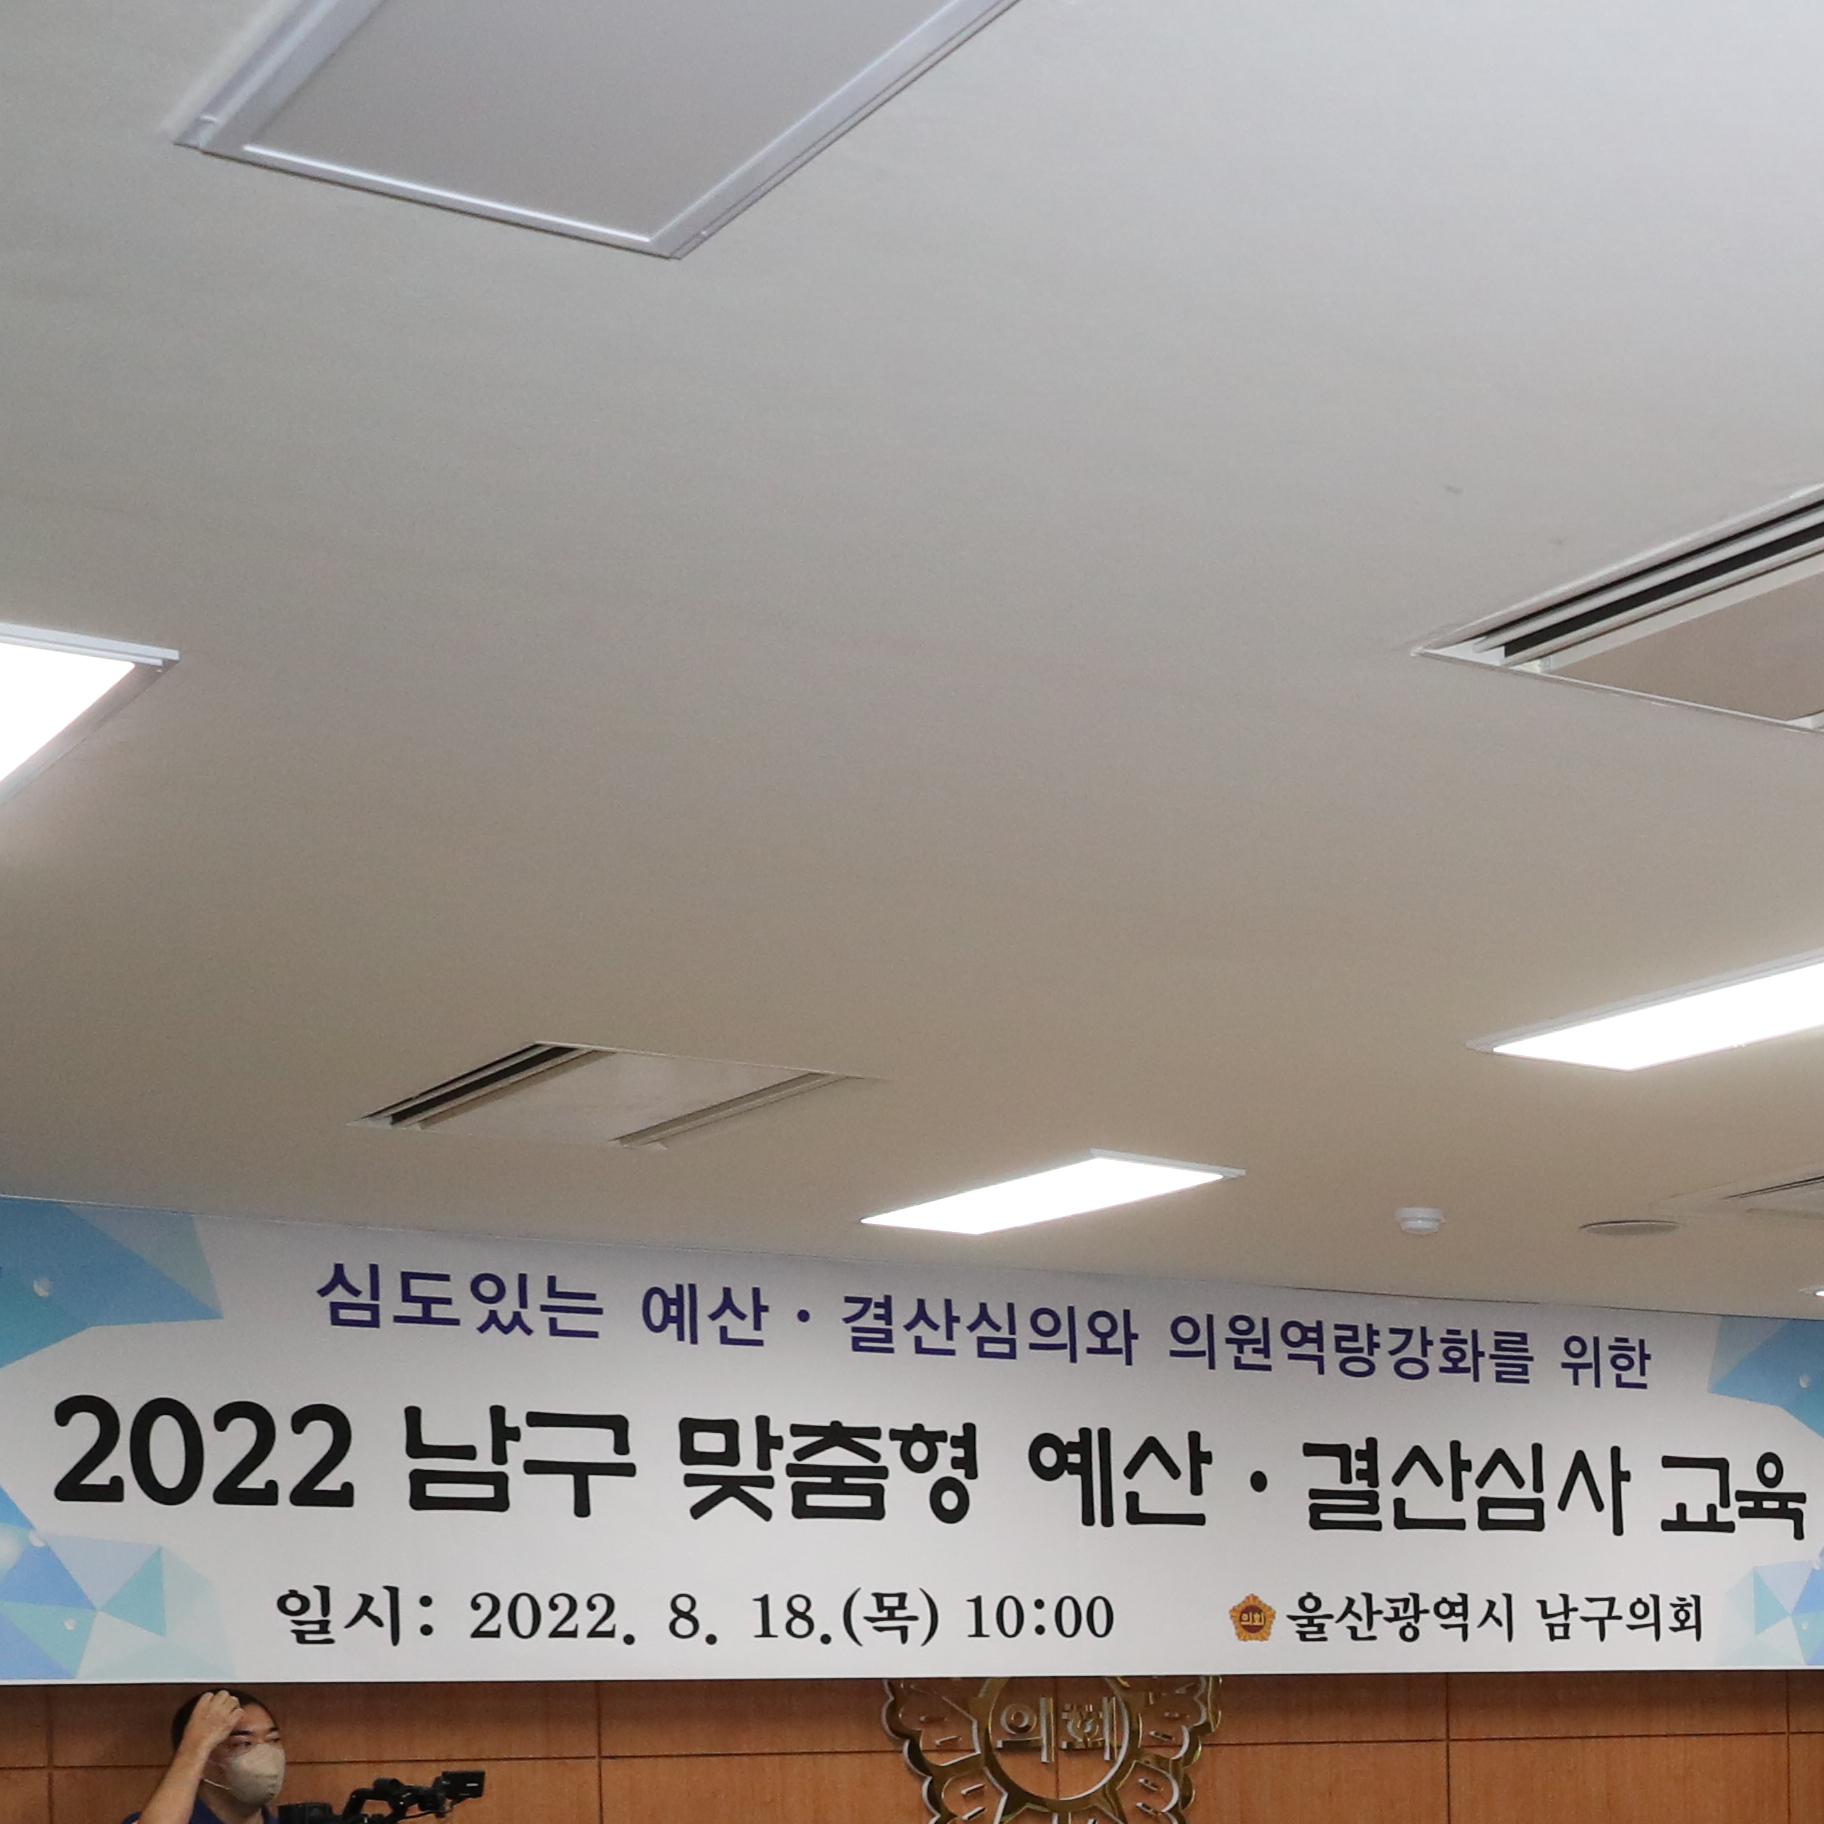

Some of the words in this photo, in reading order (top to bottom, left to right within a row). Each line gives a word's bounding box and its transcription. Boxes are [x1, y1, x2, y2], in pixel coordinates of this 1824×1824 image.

[315, 1262, 604, 1339] 심도있는
[641, 1282, 770, 1348] 예산
[841, 1293, 1140, 1368] 결산심의와
[1168, 1311, 1535, 1386] 의원역량강화를
[1560, 1334, 1652, 1390] 위한
[53, 1394, 355, 1508] 2022
[403, 1404, 637, 1519] 남구
[678, 1414, 980, 1525] 맞춤형
[1027, 1426, 1213, 1528] 예산
[1302, 1436, 1632, 1537] 결산심사
[1660, 1451, 1807, 1541] 교육
[276, 1584, 434, 1647] 일시:
[470, 1592, 636, 1646] 2022.
[668, 1593, 718, 1646] 8.
[753, 1587, 939, 1647] 18.(목)
[966, 1595, 1114, 1639] 10:00
[1239, 1610, 1266, 1627] 의회
[1286, 1591, 1514, 1643] 울산광역시
[1536, 1593, 1702, 1643] 남구의회
[995, 1696, 1121, 1764] 의회
